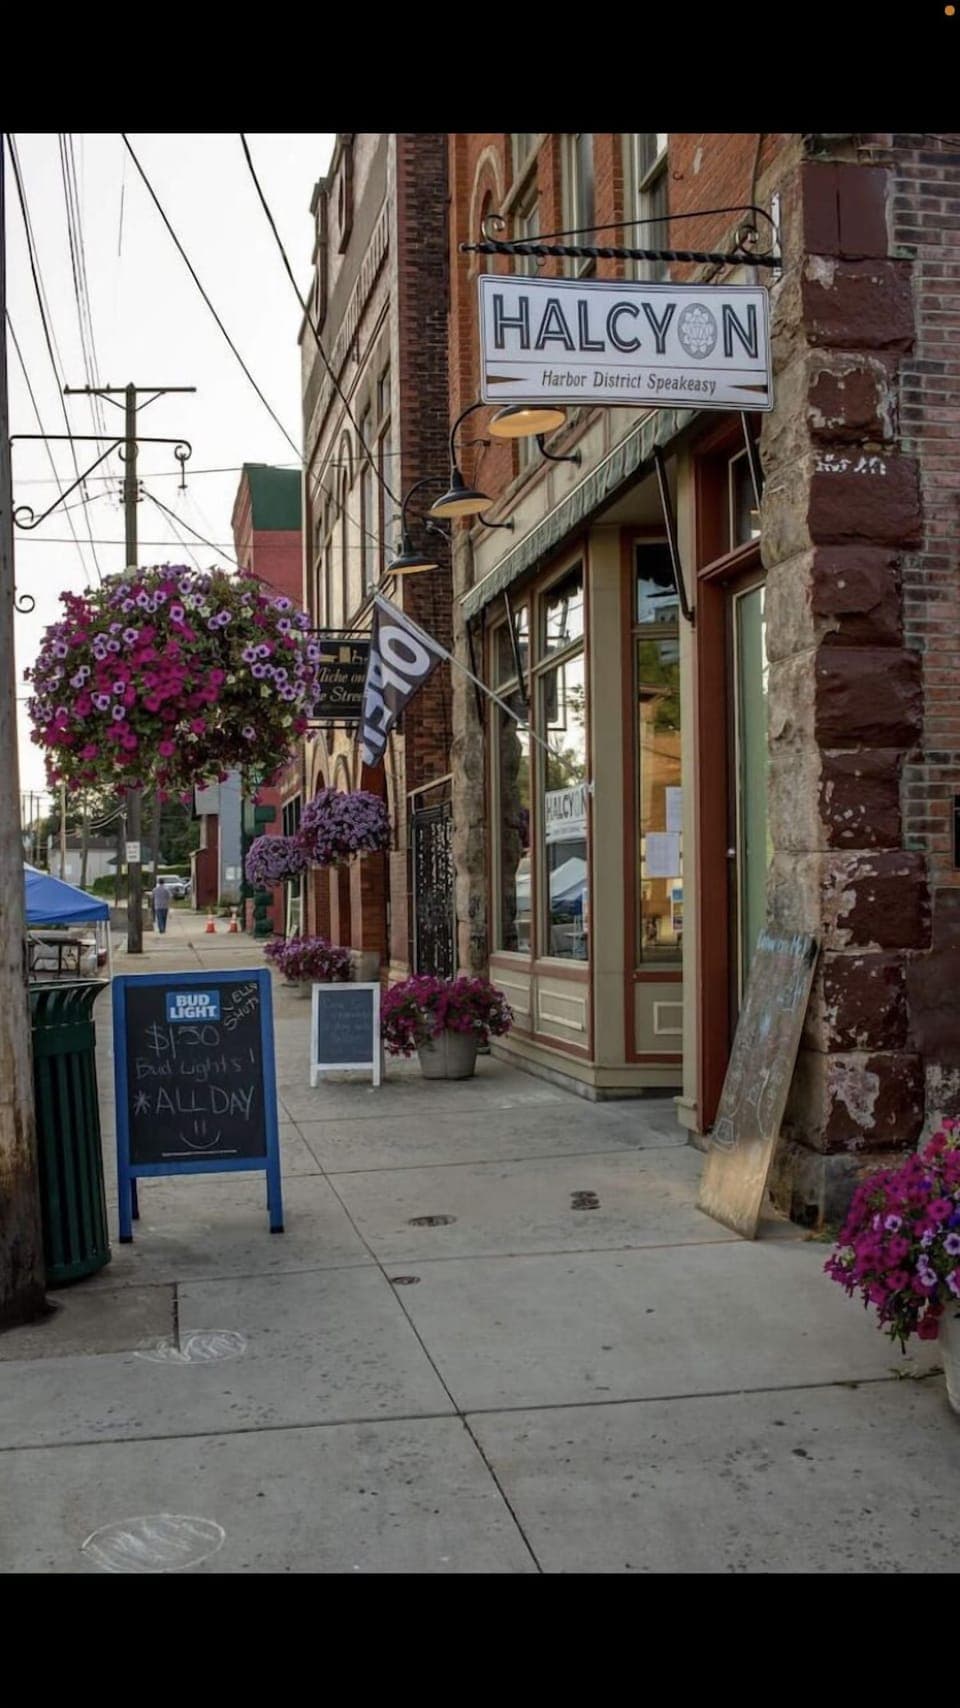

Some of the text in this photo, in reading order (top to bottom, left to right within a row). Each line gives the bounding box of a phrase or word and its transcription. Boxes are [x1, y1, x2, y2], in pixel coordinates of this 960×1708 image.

[493, 294, 759, 360] HALCYON
[542, 370, 717, 395] Harbor District Speakeasy
[170, 1005, 217, 1019] LIGHT
[176, 993, 210, 1007] BUD
[209, 1084, 254, 1121] DAY
